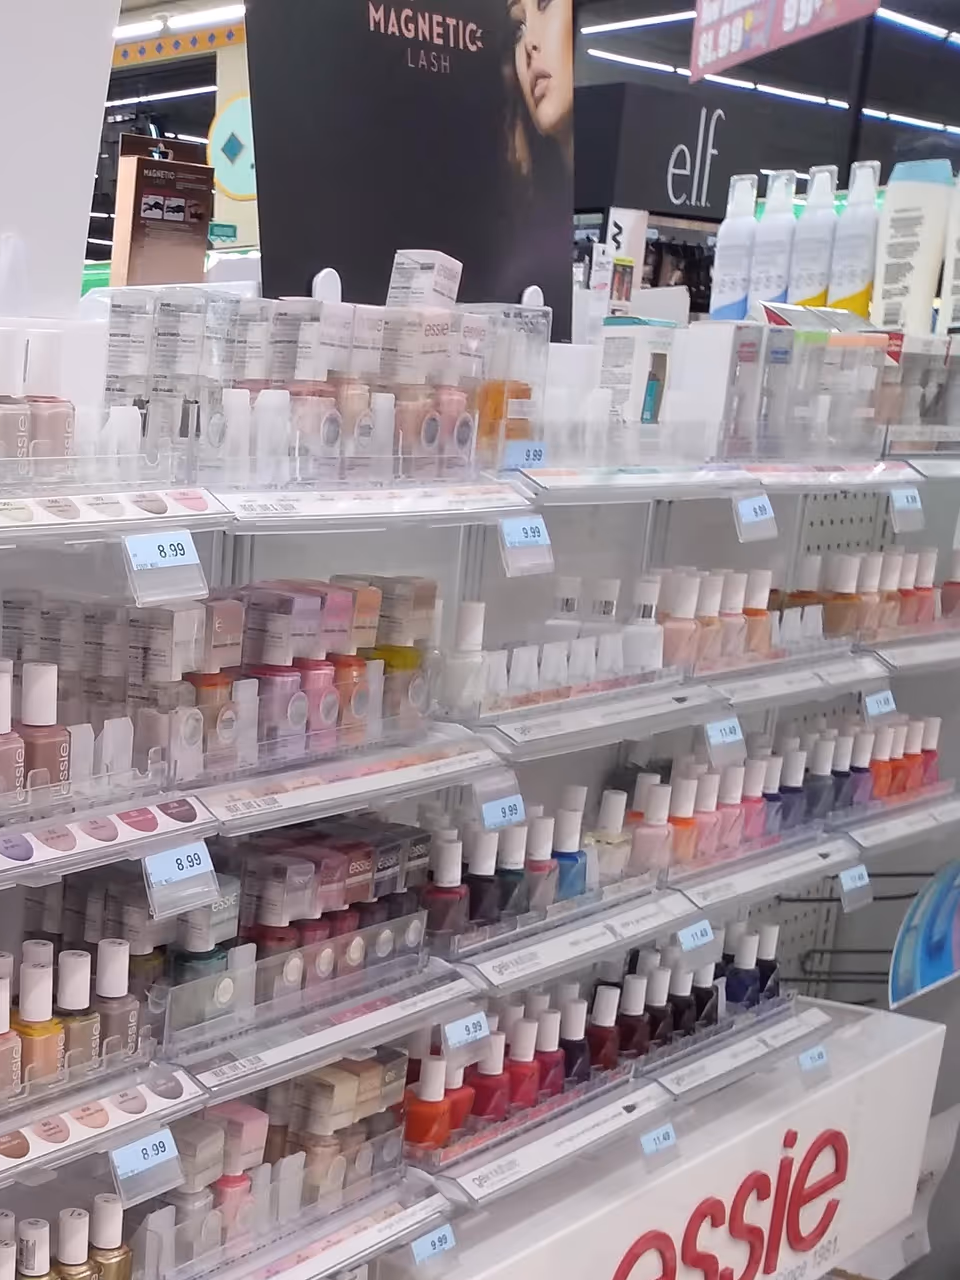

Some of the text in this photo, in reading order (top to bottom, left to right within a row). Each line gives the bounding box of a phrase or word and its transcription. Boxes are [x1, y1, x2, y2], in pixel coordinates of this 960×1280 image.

[368, 2, 483, 52] MAGNETIC
[407, 48, 451, 74] LASH
[424, 322, 450, 337] essie
[525, 449, 543, 462] 9.99
[522, 525, 541, 539] 9.99
[157, 542, 186, 559] 8.99
[718, 724, 738, 741] 11.49
[501, 803, 519, 818] 9.99
[175, 852, 202, 872] 8.99
[350, 859, 373, 874] essie
[691, 928, 709, 942] 11.49
[464, 1020, 483, 1036] 9.99
[653, 1131, 671, 1145] 11.49
[141, 1139, 166, 1161] 8.99
[431, 1233, 448, 1250] 9.99
